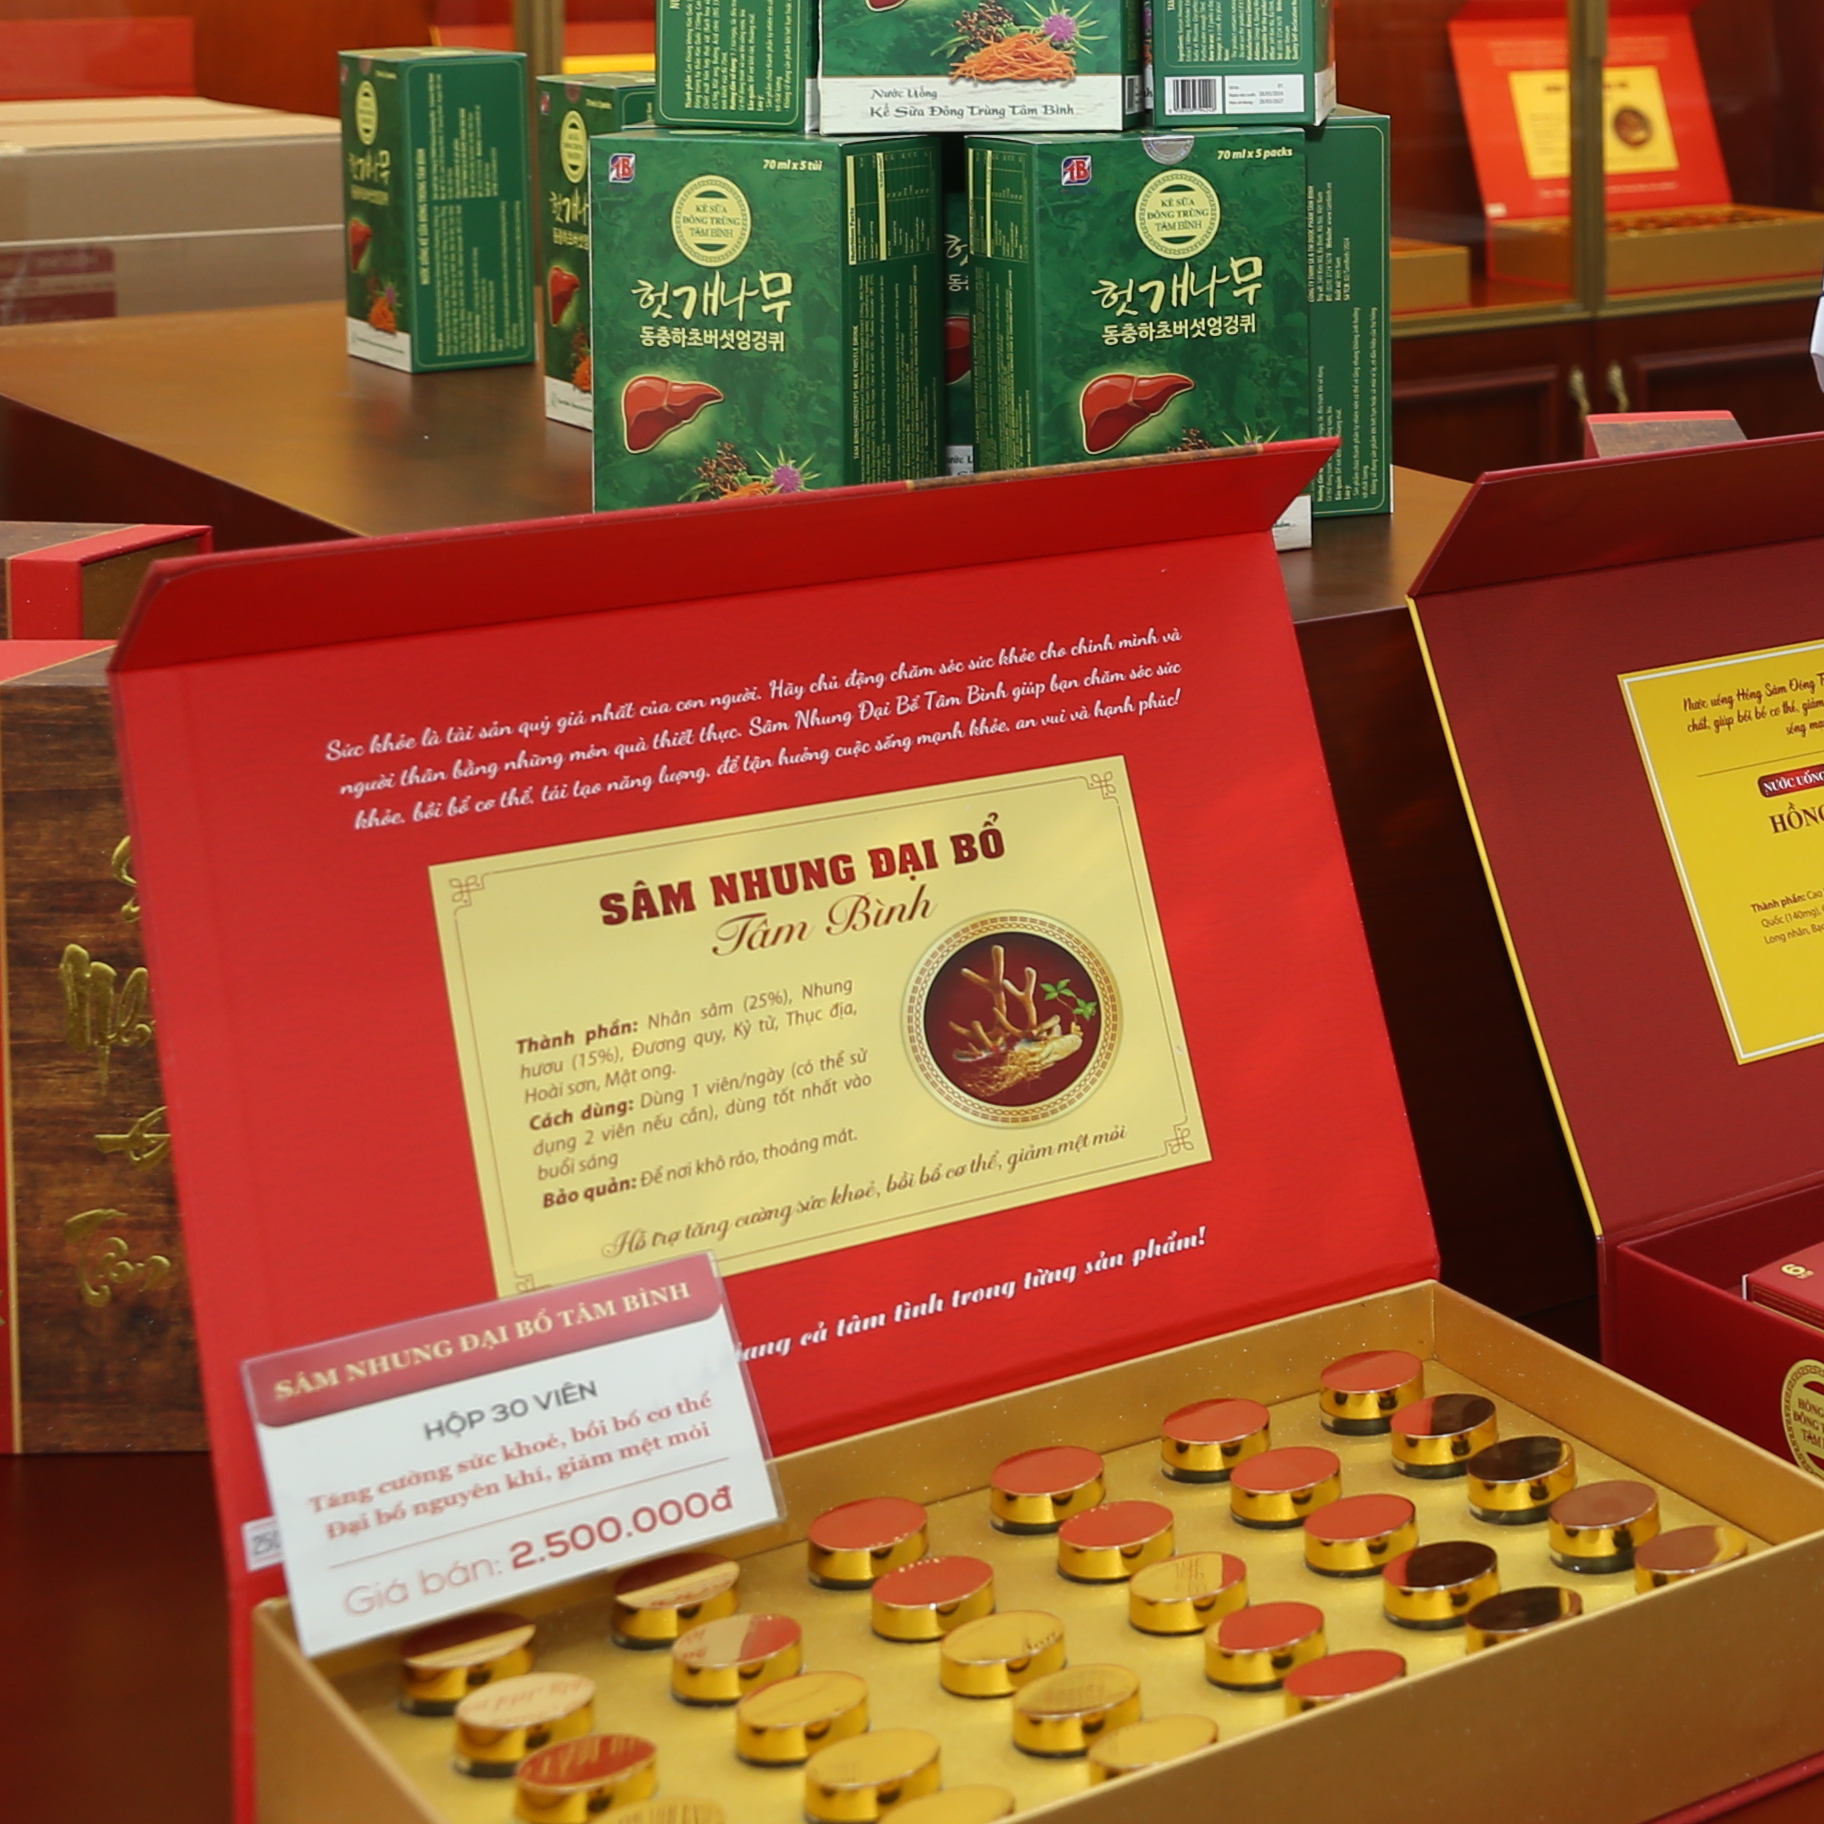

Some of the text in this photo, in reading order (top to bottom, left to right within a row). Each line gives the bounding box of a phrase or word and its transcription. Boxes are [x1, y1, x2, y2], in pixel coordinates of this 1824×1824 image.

[869, 101, 1075, 121] Kế Sữa Đông Trùng Tâm Bình
[871, 87, 901, 100] Nước
[1217, 148, 1231, 160] 70
[1233, 148, 1246, 159] ml
[1255, 148, 1263, 159] 5
[1263, 146, 1293, 161] packs
[631, 270, 794, 323] 헛개나무
[1091, 256, 1264, 316] 헛개나무
[640, 326, 786, 352] 동충하초버섯엉겅퀴
[1102, 313, 1257, 346] 동충하초버섯엉겅퀴
[1762, 774, 1795, 796] NƯỚC
[599, 812, 1006, 927] SÂM NHUNG ĐẠI BỔ
[710, 881, 938, 958] Tâm Bình
[836, 1225, 1207, 1340] tâm tình trong từng sản phẩm!
[272, 1280, 692, 1403] SÂM NHUNG ĐẠI BỔ TÂM BÌNH
[422, 1379, 599, 1442] HỘP 30 VIÊN
[342, 1484, 735, 1617] Giá bán: 2.500.000đ
